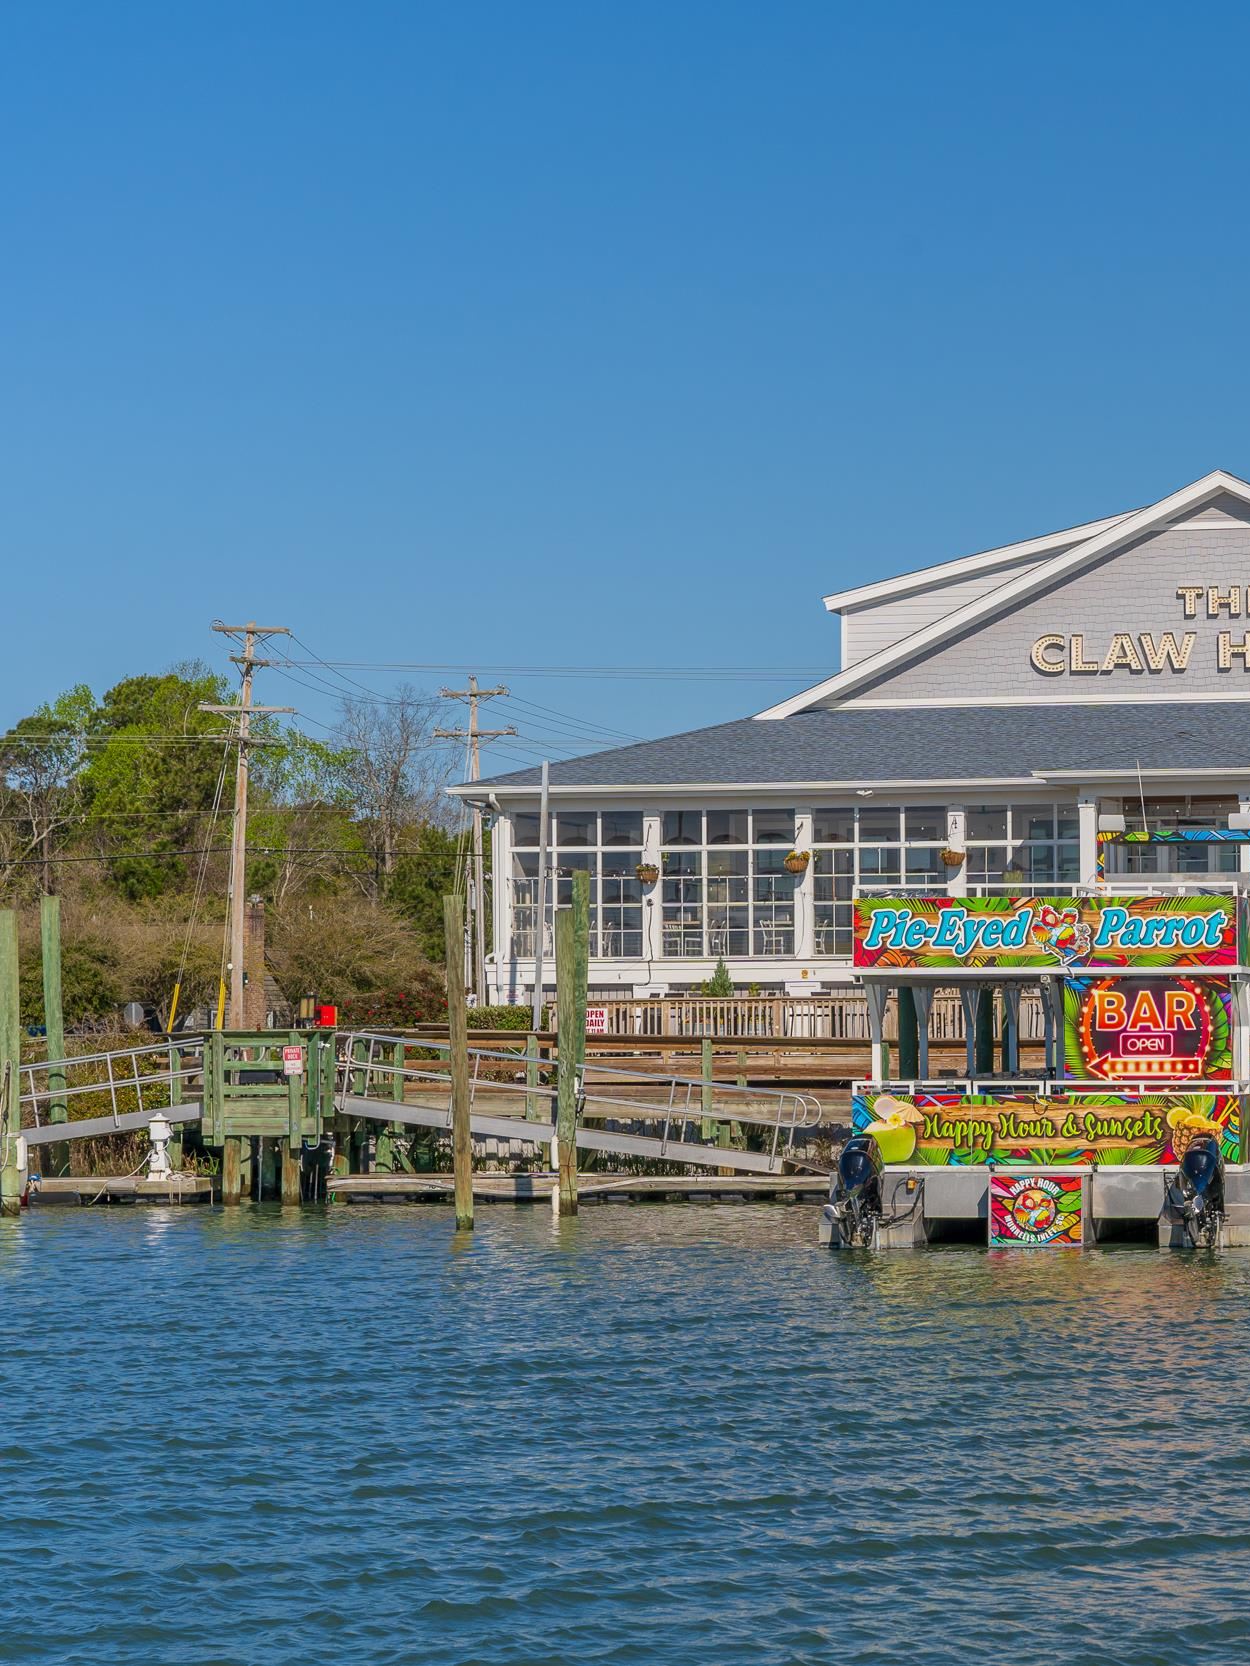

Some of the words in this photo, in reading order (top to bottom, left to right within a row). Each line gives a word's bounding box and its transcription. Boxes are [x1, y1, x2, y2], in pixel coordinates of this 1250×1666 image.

[1030, 631, 1197, 675] CLAW
[863, 907, 1034, 957] Pie-Eyed
[1094, 907, 1228, 948] Parrot
[1095, 990, 1197, 1031] BAR
[1127, 1038, 1165, 1052] OPEN
[923, 1112, 994, 1151] Happy
[998, 1111, 1056, 1139] Hour
[1060, 1111, 1081, 1138] &
[1083, 1110, 1164, 1142] Sunsets
[1009, 1178, 1036, 1195] HAPPY
[1037, 1178, 1060, 1196] HOUR
[1004, 1214, 1036, 1242] MURRELLS
[1037, 1227, 1057, 1242] INLET
[1055, 1214, 1065, 1226] SC
